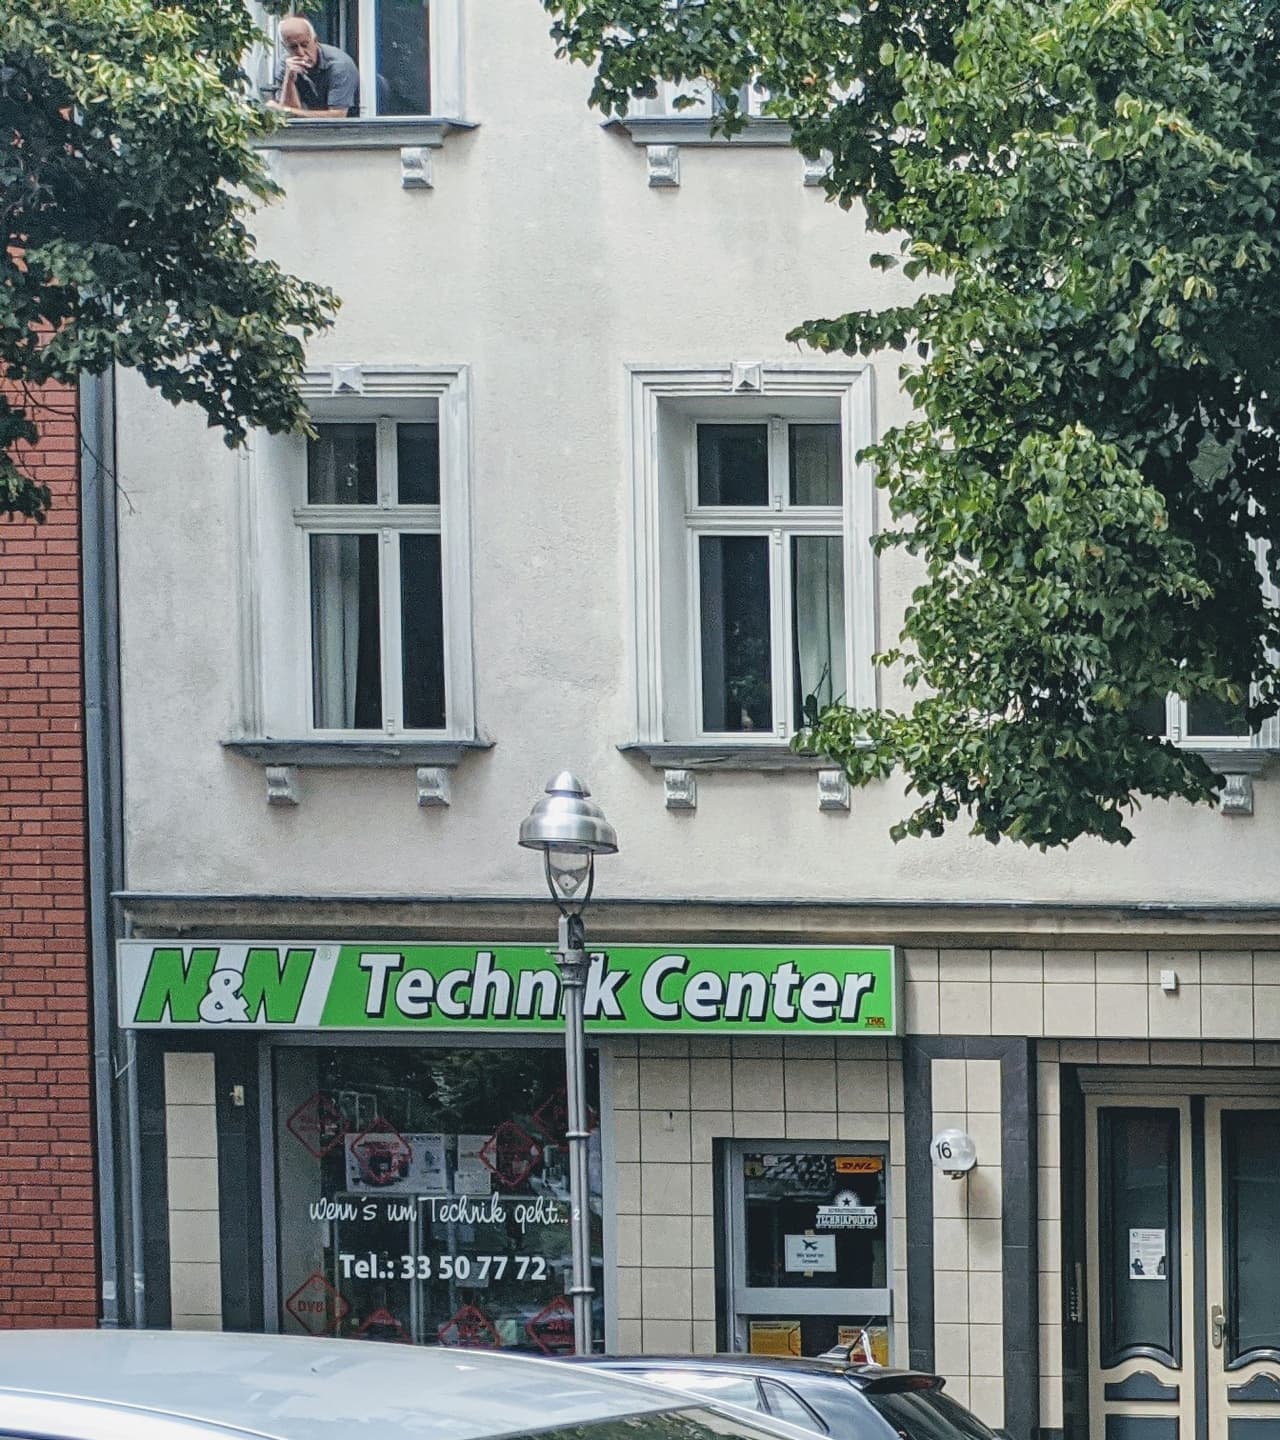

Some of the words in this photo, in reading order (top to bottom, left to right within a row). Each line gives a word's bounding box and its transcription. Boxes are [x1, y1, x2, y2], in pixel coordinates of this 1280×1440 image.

[133, 947, 317, 1024] N&N
[358, 950, 632, 1020] Technk
[639, 953, 876, 1023] Center
[936, 1141, 952, 1160] 16
[387, 1203, 417, 1222] um
[417, 1192, 507, 1224] Technik
[338, 1254, 394, 1280] Tel.:
[401, 1256, 433, 1280] 33
[438, 1256, 471, 1280] 50
[476, 1256, 510, 1280] 77
[514, 1257, 547, 1281] 72
